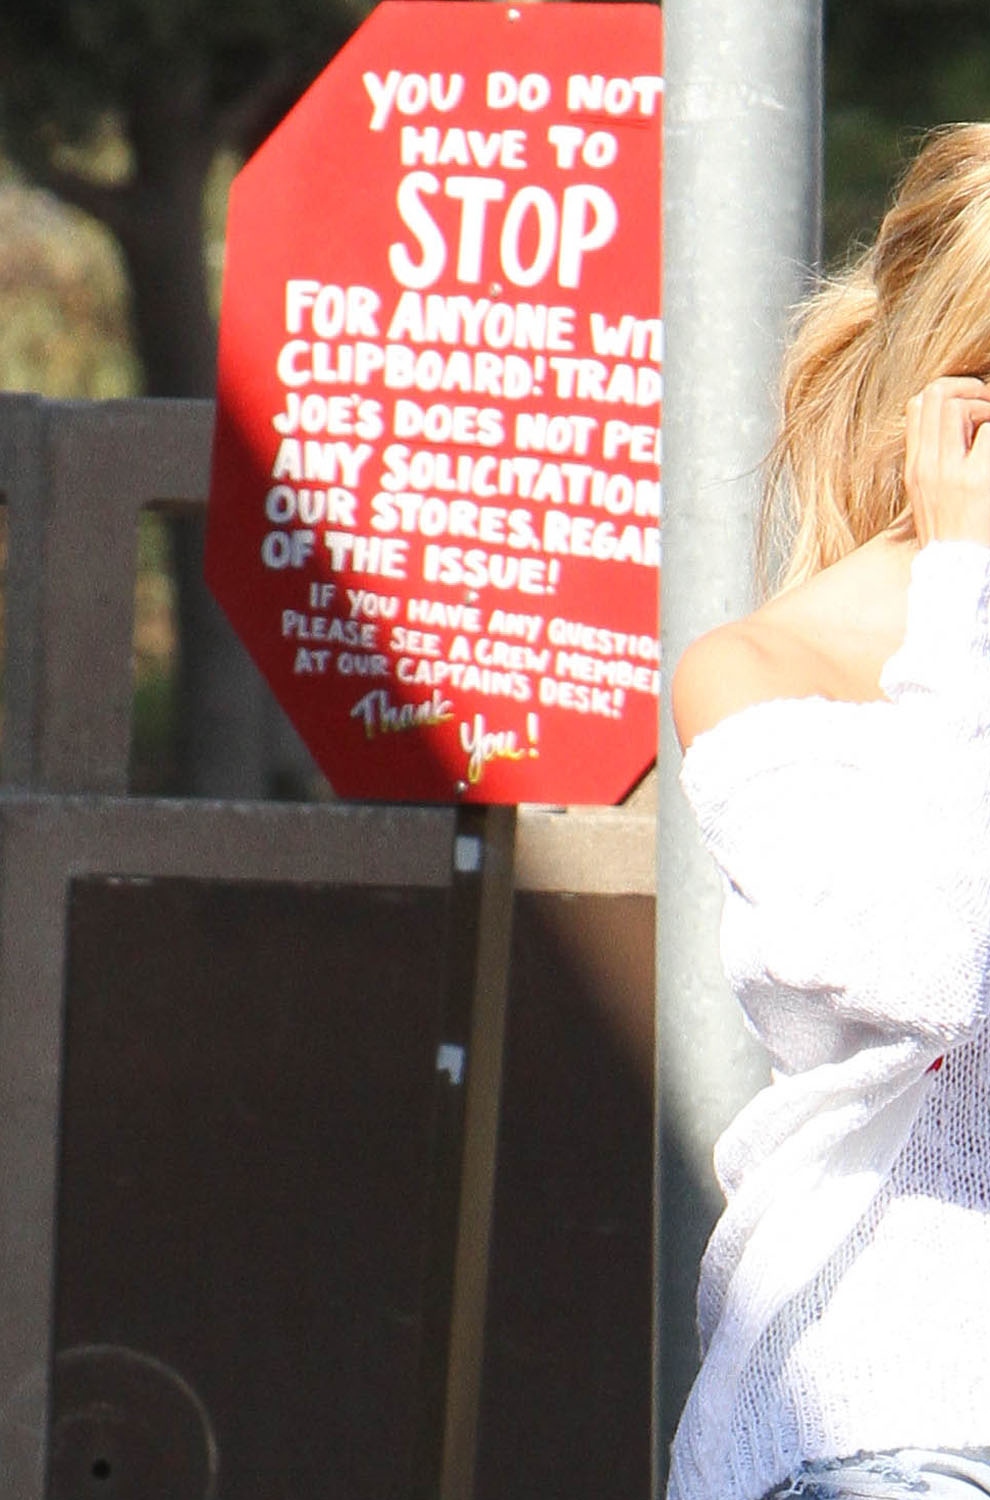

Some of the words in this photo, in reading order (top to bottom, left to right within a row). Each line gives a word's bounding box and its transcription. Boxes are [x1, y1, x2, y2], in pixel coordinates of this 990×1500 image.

[363, 70, 464, 131] YOU
[487, 72, 549, 110] DO
[567, 74, 663, 117] NOT
[401, 126, 527, 168] HAVE
[548, 125, 618, 168] TO
[389, 171, 618, 289] STOP
[285, 279, 381, 338] FOR
[387, 291, 576, 352] ANYONE
[277, 340, 545, 399] CLIPBOARD!
[273, 393, 384, 440] JOE'S
[394, 399, 504, 448] DOES
[515, 413, 598, 456] NOT
[272, 438, 373, 488] ANY
[265, 485, 357, 527] OUR
[261, 530, 315, 570] OF
[325, 530, 409, 580] THE
[424, 544, 560, 594] ISSUE!
[282, 610, 378, 648] PLEASE
[389, 627, 441, 655] SEE
[450, 635, 471, 661] A
[474, 638, 552, 673] CREW
[310, 582, 336, 608] IF
[347, 589, 398, 620] YOU
[407, 598, 482, 633] HAVE
[488, 610, 543, 643] ANY
[548, 618, 661, 660] QUESTIO
[295, 647, 330, 676] AT
[337, 652, 390, 676] OUR
[538, 676, 625, 719] DESK!
[350, 688, 454, 740] Thank
